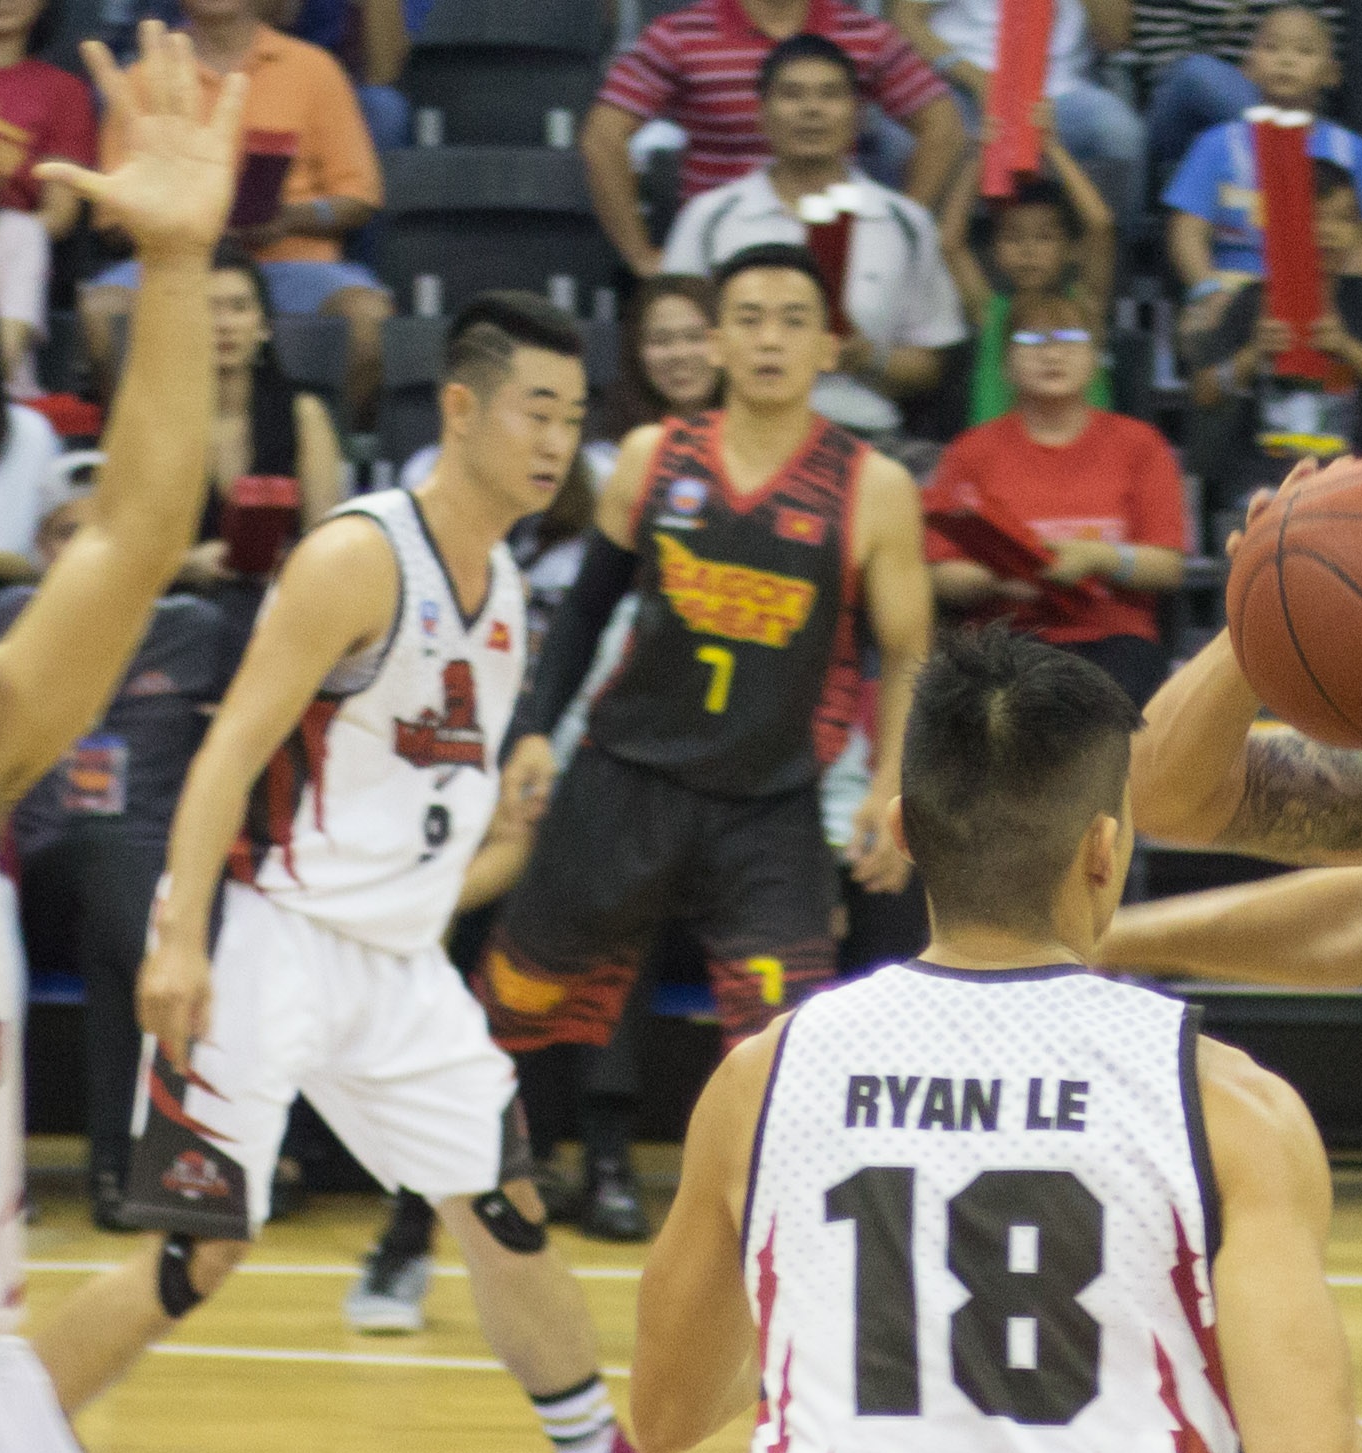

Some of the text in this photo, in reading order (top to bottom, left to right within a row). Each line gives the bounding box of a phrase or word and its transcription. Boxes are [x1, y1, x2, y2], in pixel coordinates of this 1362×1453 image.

[696, 645, 735, 715] 7
[747, 954, 784, 1006] 7
[845, 1074, 1090, 1132] RYAN LE
[824, 1166, 1105, 1426] 18
